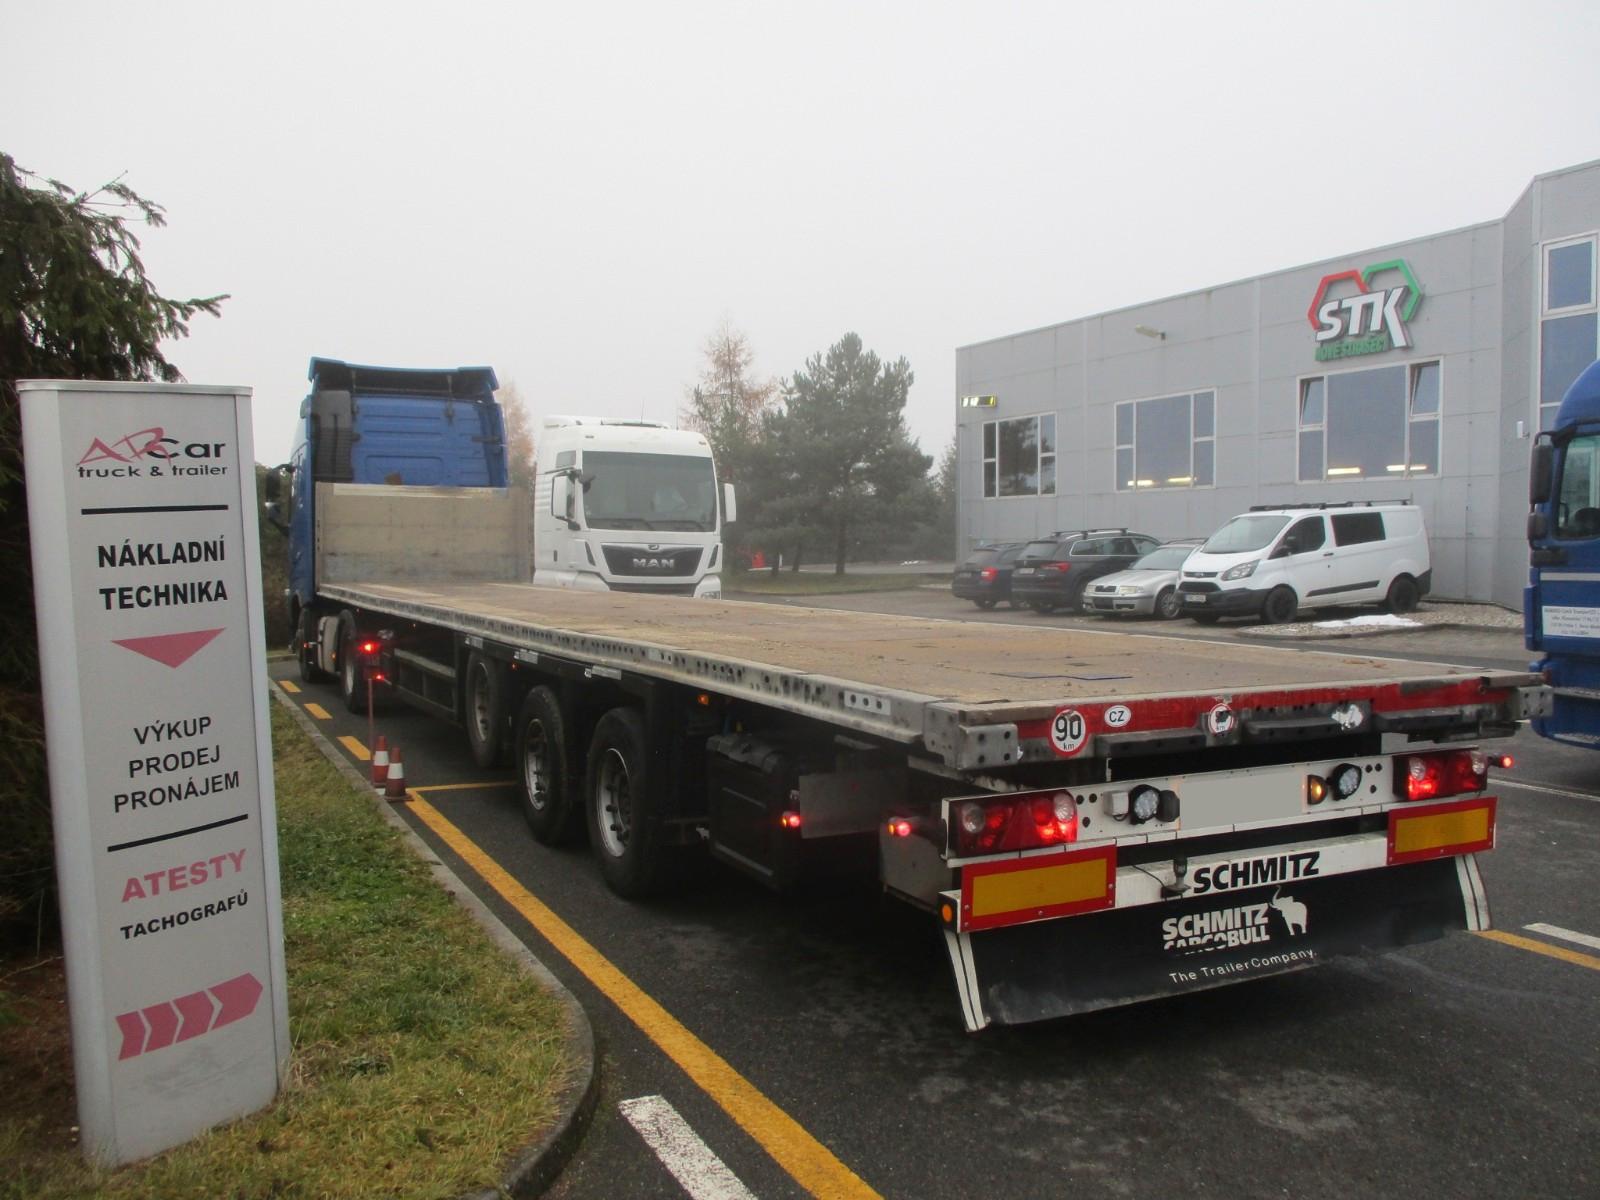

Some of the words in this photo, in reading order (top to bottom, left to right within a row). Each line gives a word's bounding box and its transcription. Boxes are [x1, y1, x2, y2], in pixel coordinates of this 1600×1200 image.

[1315, 286, 1410, 349] STK
[78, 466, 141, 478] truck
[150, 466, 163, 477] &
[172, 464, 228, 476] trailer
[97, 534, 226, 568] NÁKLADNÍ
[633, 558, 675, 568] MAN
[99, 580, 228, 610] TECHNIKA
[133, 716, 212, 745] VÝKUP
[1055, 714, 1082, 741] 90
[1109, 710, 1125, 723] CZ
[129, 744, 221, 778] PRODEJ
[1063, 742, 1075, 750] km
[114, 770, 240, 813] PRONÁJEM
[121, 848, 247, 902] ATESTY
[1193, 851, 1320, 894] SCHMITZ
[120, 888, 249, 940] TACHOGRAFŮ
[1162, 902, 1269, 941] SCHMITZ
[1169, 970, 1197, 984] The
